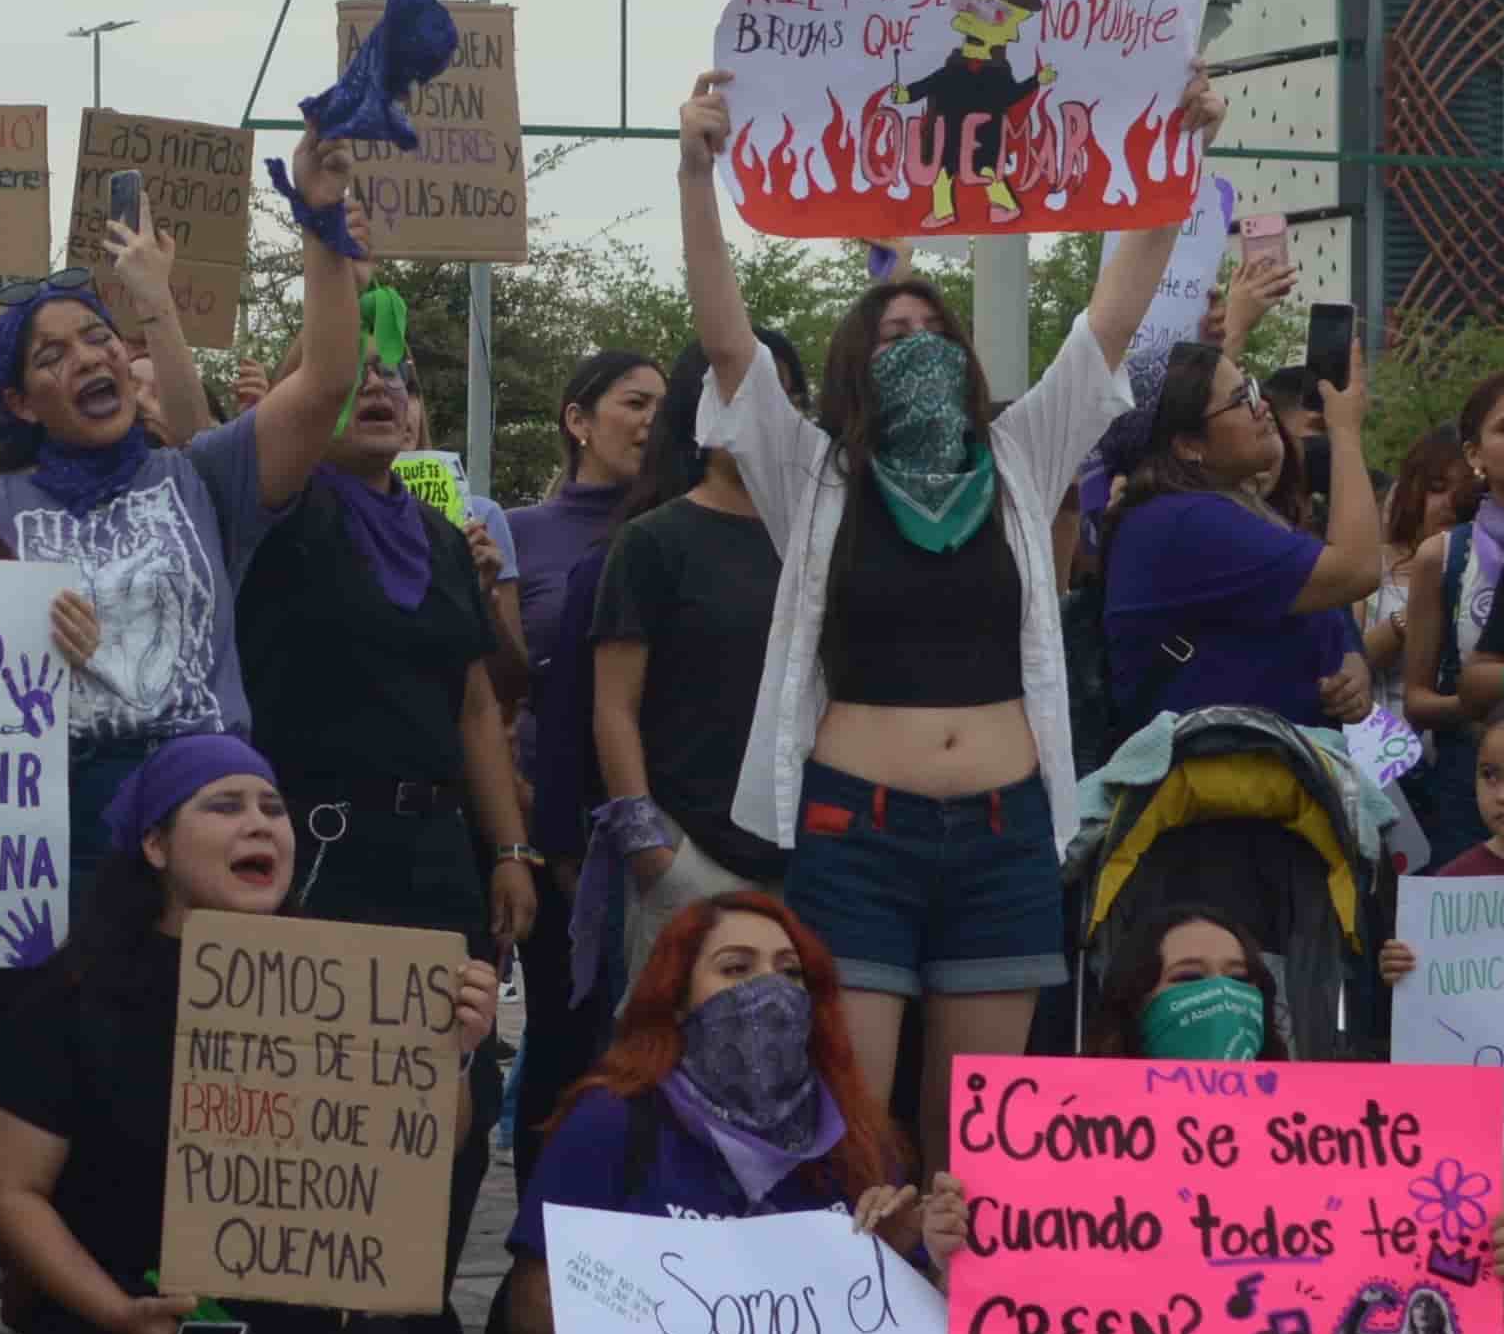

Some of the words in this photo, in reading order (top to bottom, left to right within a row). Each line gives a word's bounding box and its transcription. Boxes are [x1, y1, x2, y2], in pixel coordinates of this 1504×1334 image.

[734, 11, 845, 56] BRUJAS
[863, 14, 921, 59] QUE
[158, 130, 246, 177] niñas
[860, 101, 1097, 193] QUEMAR
[404, 182, 444, 218] LAS
[450, 183, 516, 218] ACOSO
[189, 943, 345, 1021] SOMOS
[369, 957, 457, 1034] LAS
[189, 1028, 297, 1079] NIETAS
[316, 1032, 355, 1081] DE
[372, 1039, 437, 1091] LAS
[182, 1082, 295, 1139] BRUJAS
[311, 1099, 370, 1146] QUE
[392, 1108, 438, 1158] NO
[959, 1073, 1156, 1162] ¿Cómo
[1177, 1115, 1239, 1168] se
[1267, 1100, 1422, 1168] siente
[177, 1144, 377, 1215] PUDIERON
[215, 1218, 386, 1287] QUEMAR
[1361, 1197, 1418, 1257] te
[848, 1235, 900, 1334] el
